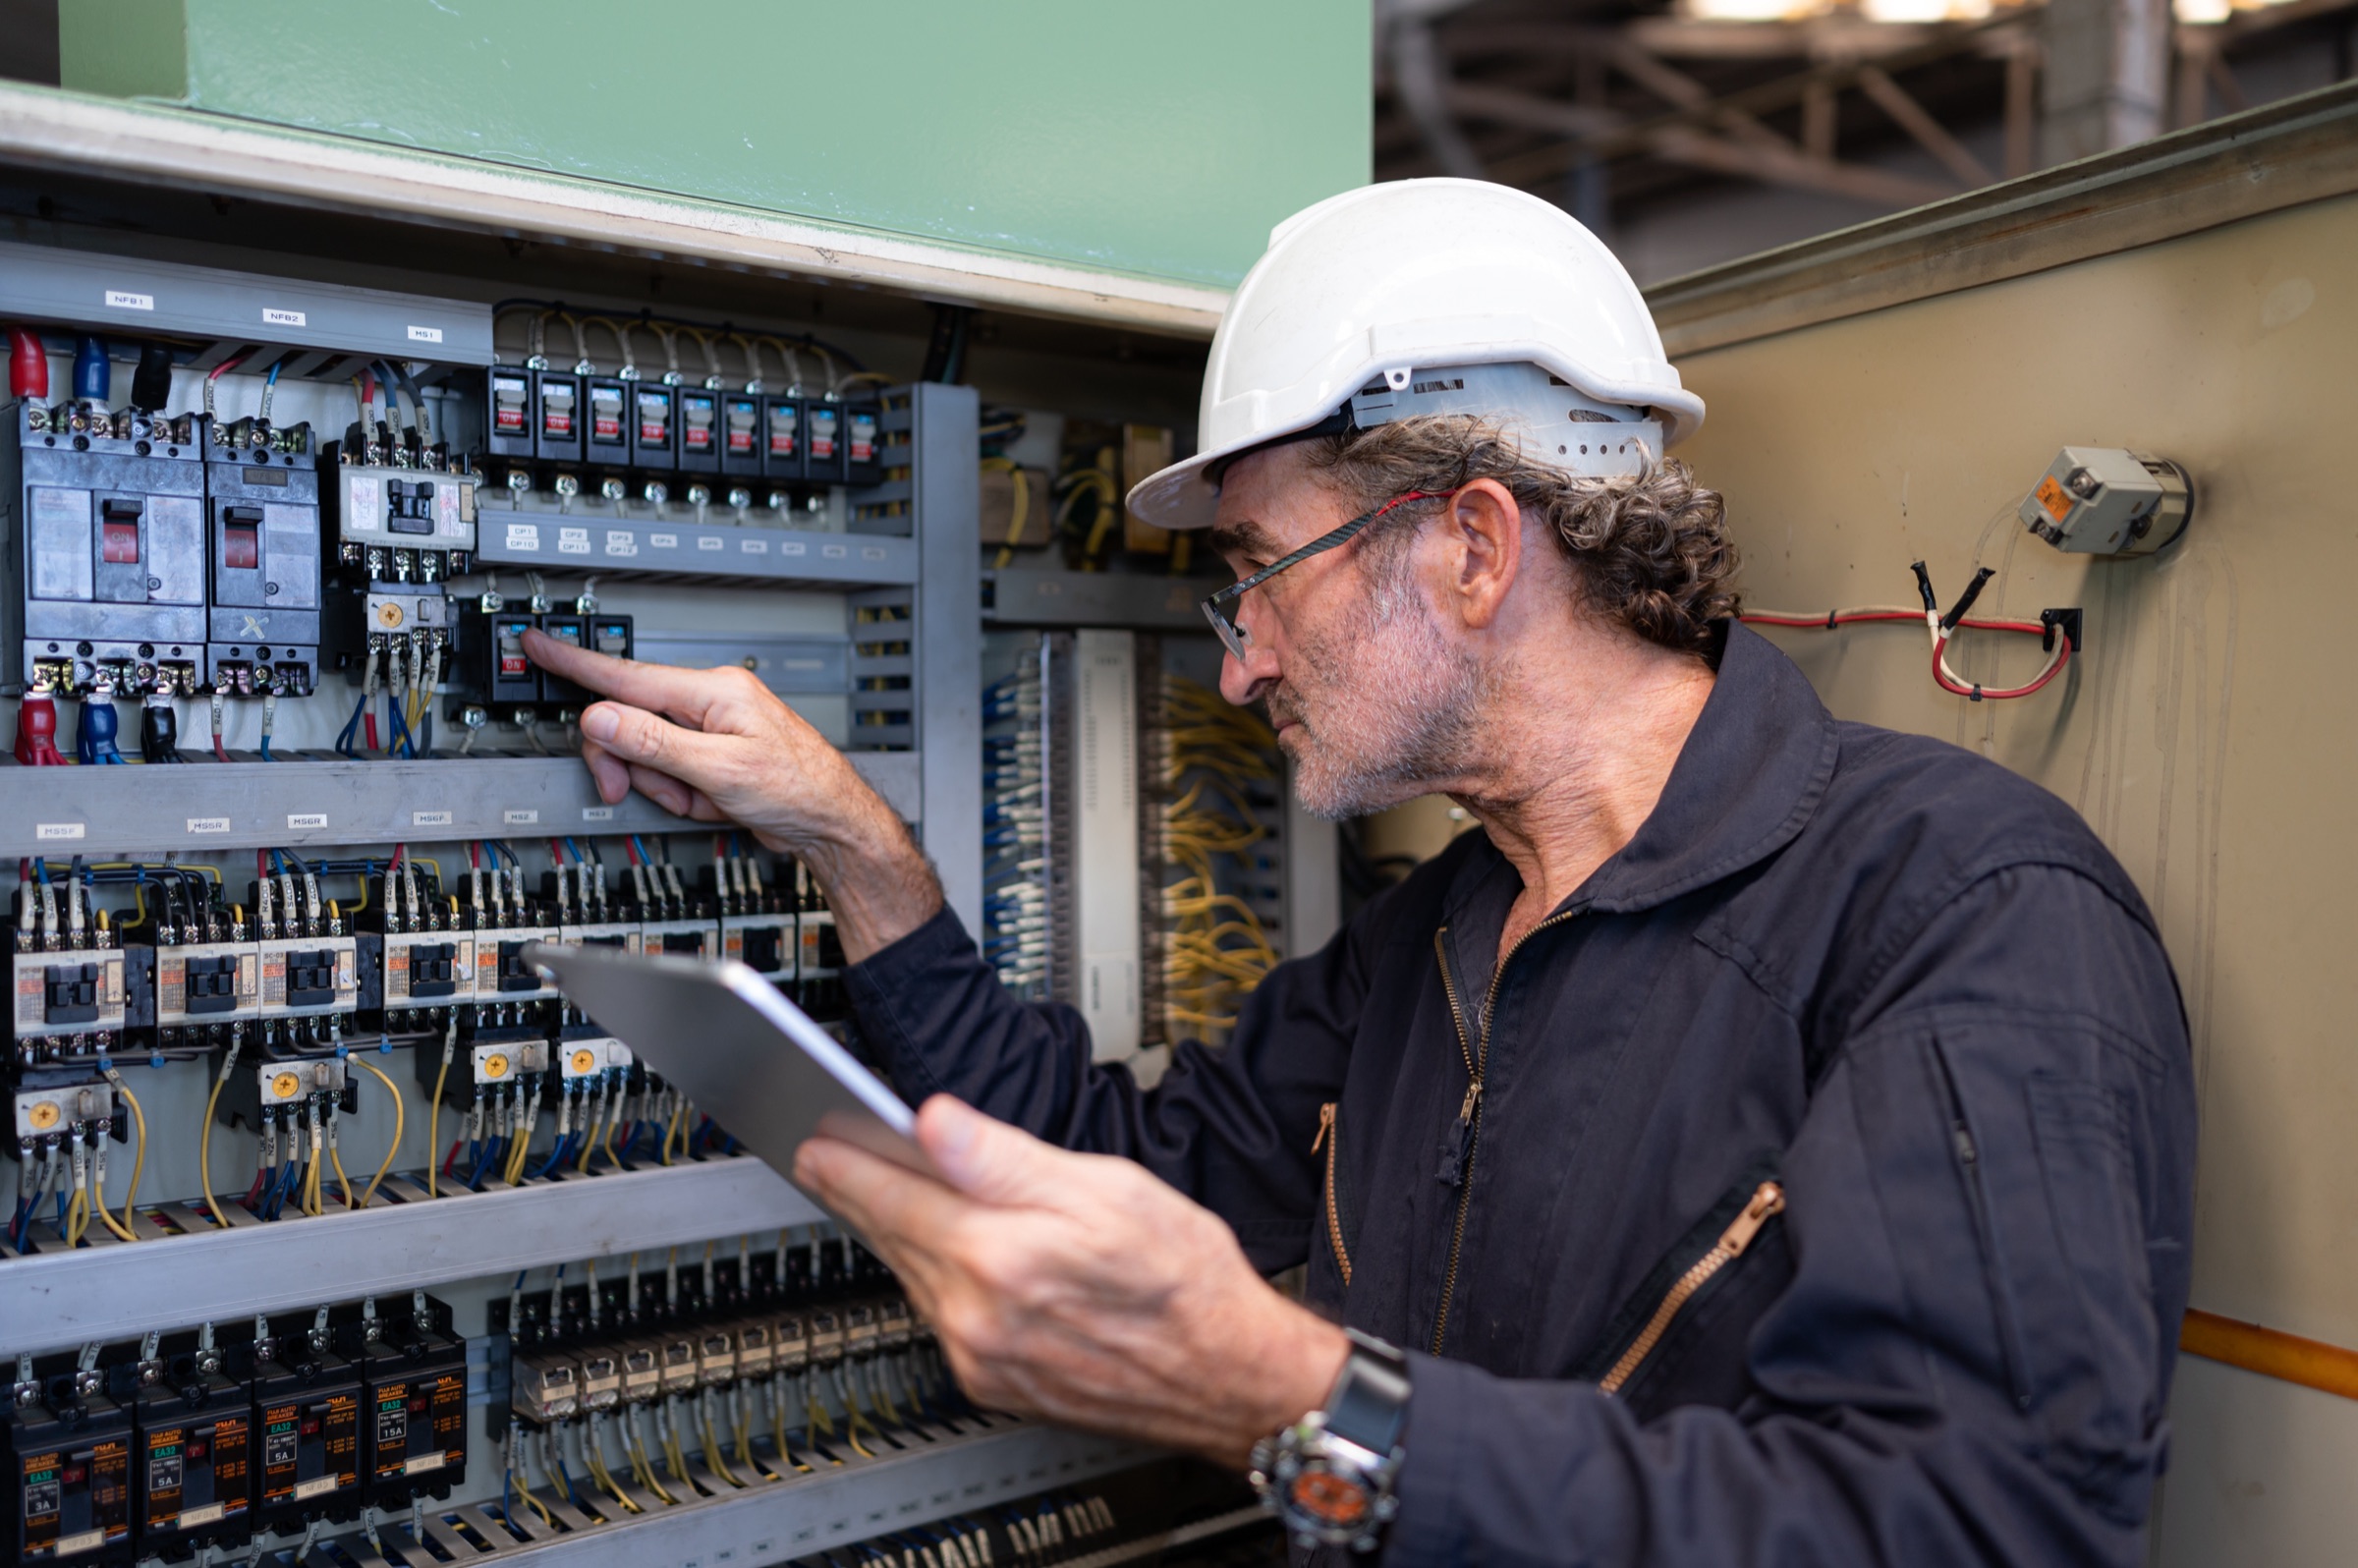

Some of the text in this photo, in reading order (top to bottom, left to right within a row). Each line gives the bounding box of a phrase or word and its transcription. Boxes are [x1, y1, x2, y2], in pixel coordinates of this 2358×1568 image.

[115, 296, 143, 306] NFB1
[270, 312, 299, 322] NFB2
[416, 330, 433, 339] MS1
[502, 414, 517, 422] ON
[550, 418, 565, 427] ON
[599, 422, 613, 431] ON
[111, 531, 130, 541] ON
[506, 660, 521, 670] ON
[309, 879, 317, 906] T400
[406, 876, 415, 903] R400
[285, 880, 294, 910] S400
[45, 891, 55, 920] S400
[312, 1113, 322, 1138] S100
[74, 1150, 83, 1178] S100
[382, 1399, 401, 1411] EA32
[266, 1411, 295, 1422] BREAKER
[271, 1422, 292, 1433] EA32
[383, 1428, 403, 1437] 15A
[150, 1435, 179, 1445] BREAKER
[154, 1445, 176, 1458] EA32
[275, 1451, 289, 1461] 5A
[29, 1470, 53, 1484] EA32
[158, 1476, 173, 1486] 5A
[35, 1500, 51, 1512] 3A
